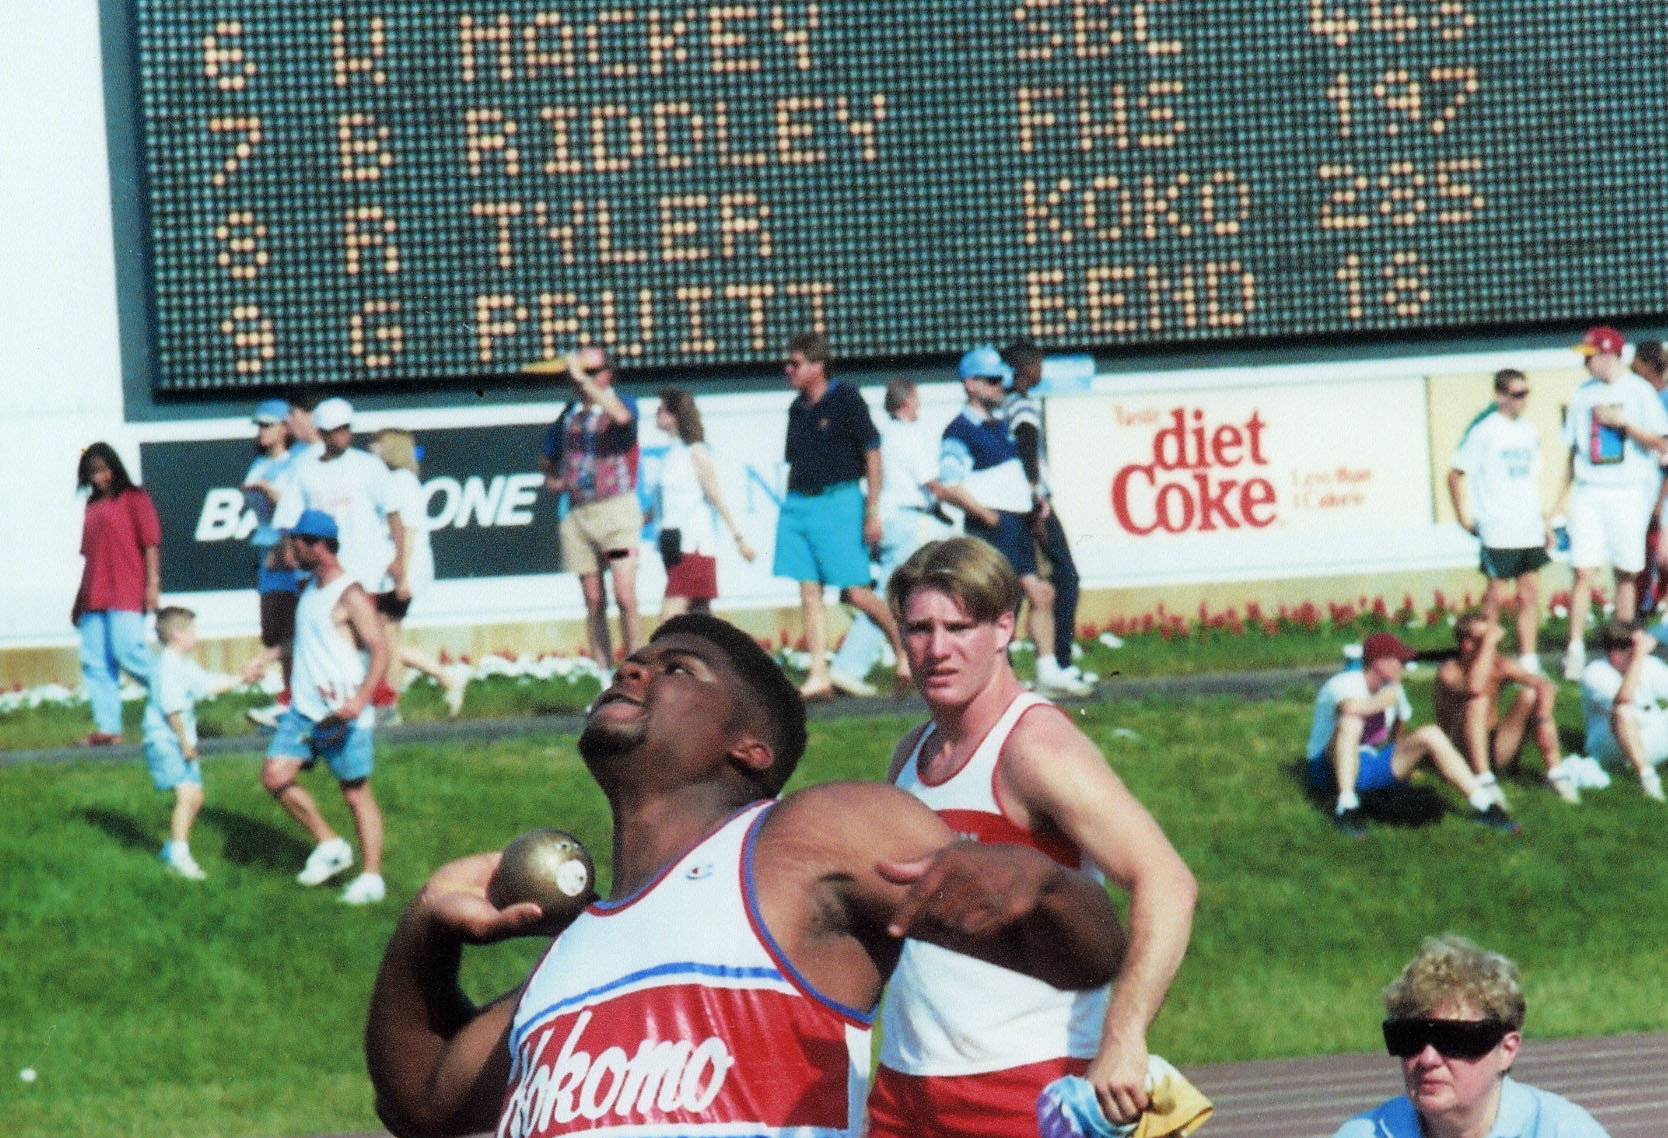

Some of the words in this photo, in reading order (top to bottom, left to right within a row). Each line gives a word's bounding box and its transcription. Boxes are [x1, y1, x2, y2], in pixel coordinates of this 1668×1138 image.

[204, 22, 255, 89] 6
[333, 18, 385, 85] W
[461, 5, 818, 81] MACKEY
[211, 118, 260, 185] 7
[339, 114, 392, 180] B
[1019, 82, 1185, 151] FWS
[1327, 68, 1478, 136] 197
[216, 213, 268, 278] 8
[472, 194, 771, 267] TYLER
[1024, 172, 1249, 243] KOKO
[1320, 160, 1484, 228] 285
[222, 306, 274, 372] 9
[351, 302, 402, 366] G
[477, 283, 832, 361] PRUITT
[1027, 261, 1254, 335] BEND
[1337, 253, 1430, 317] 18
[1154, 408, 1268, 470] diet
[419, 473, 546, 531] ONE
[1111, 464, 1277, 535] Coke
